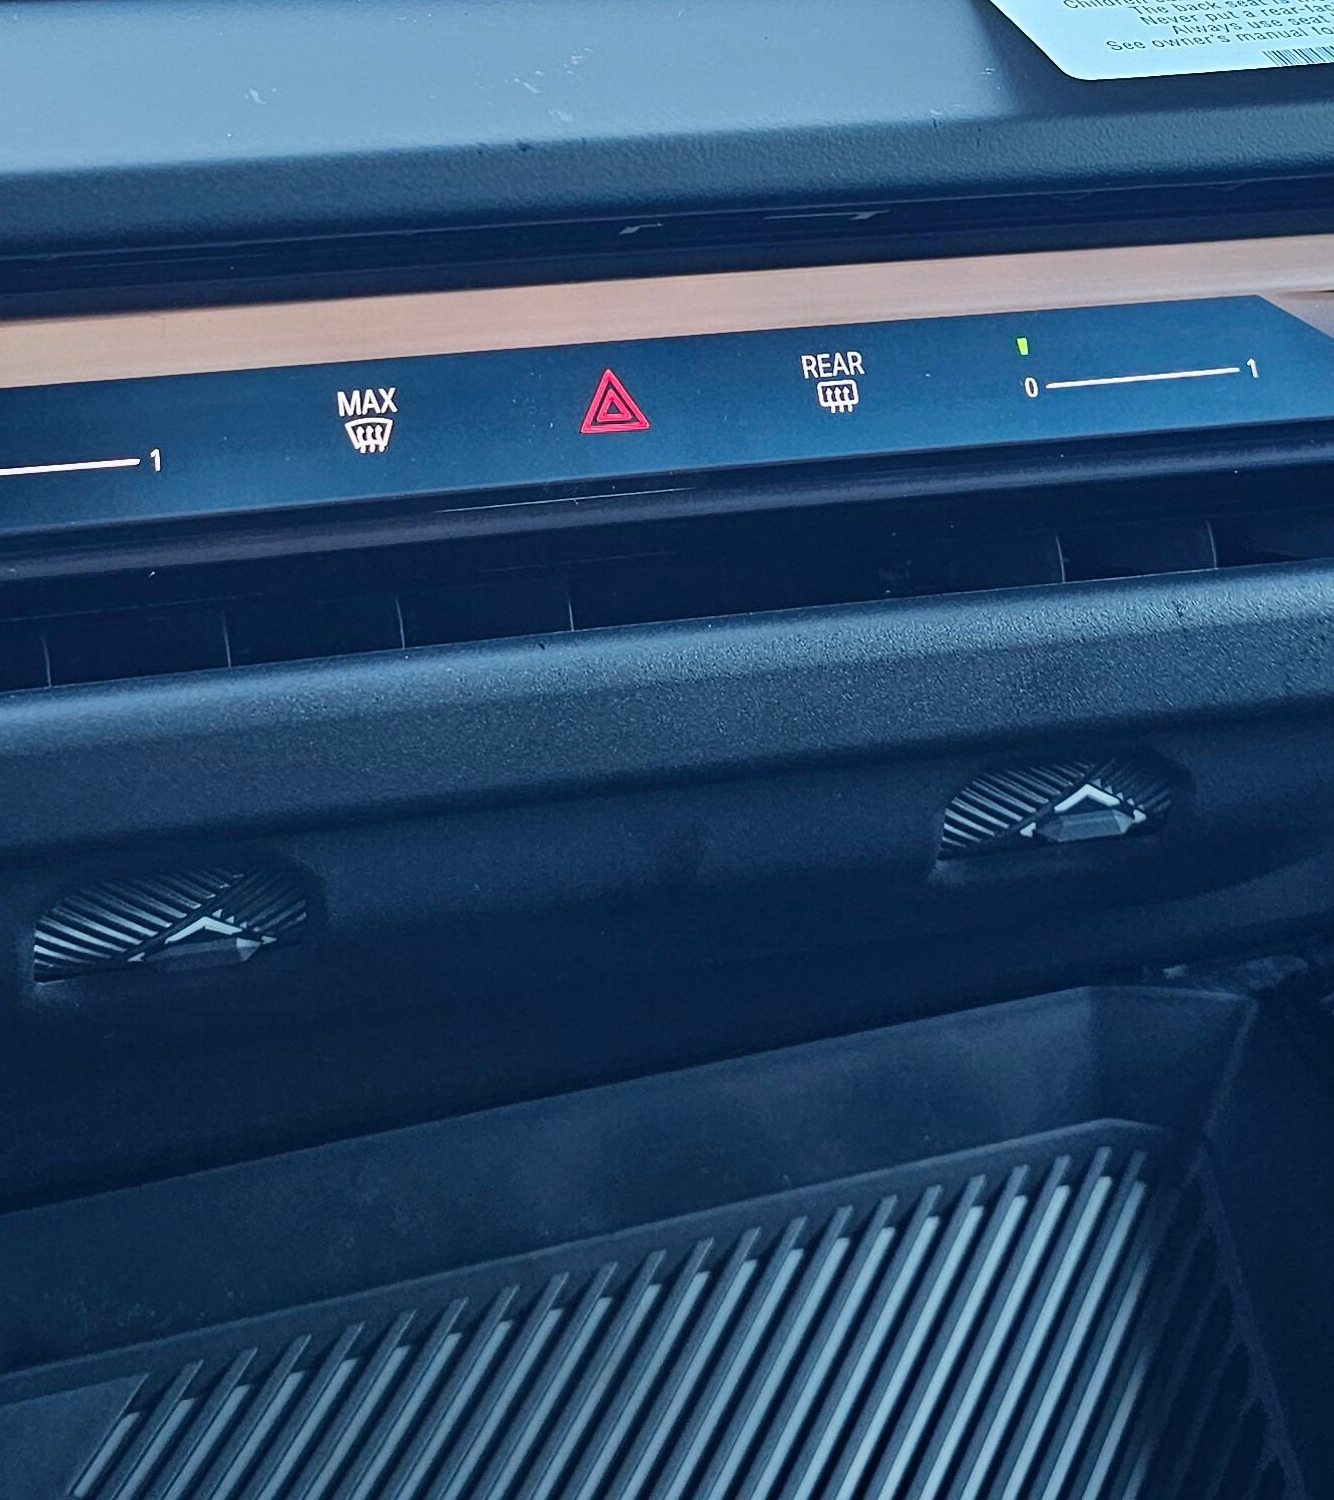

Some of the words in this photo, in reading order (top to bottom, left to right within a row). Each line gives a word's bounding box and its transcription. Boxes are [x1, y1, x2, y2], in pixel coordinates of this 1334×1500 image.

[1127, 5, 1169, 15] The
[1171, 0, 1223, 12] back
[1139, 14, 1199, 26] Never
[1205, 10, 1241, 22] put
[1242, 10, 1257, 18] a
[1172, 20, 1243, 35] Always
[1247, 19, 1284, 28] use
[1288, 15, 1331, 26] seat
[1106, 39, 1146, 51] See
[1151, 34, 1231, 48] owner's
[1236, 27, 1310, 42] manual
[800, 350, 866, 380] REAR
[1024, 376, 1039, 398] 0
[1246, 357, 1260, 379] 1
[336, 386, 399, 418] MAX
[149, 448, 161, 472] 1
